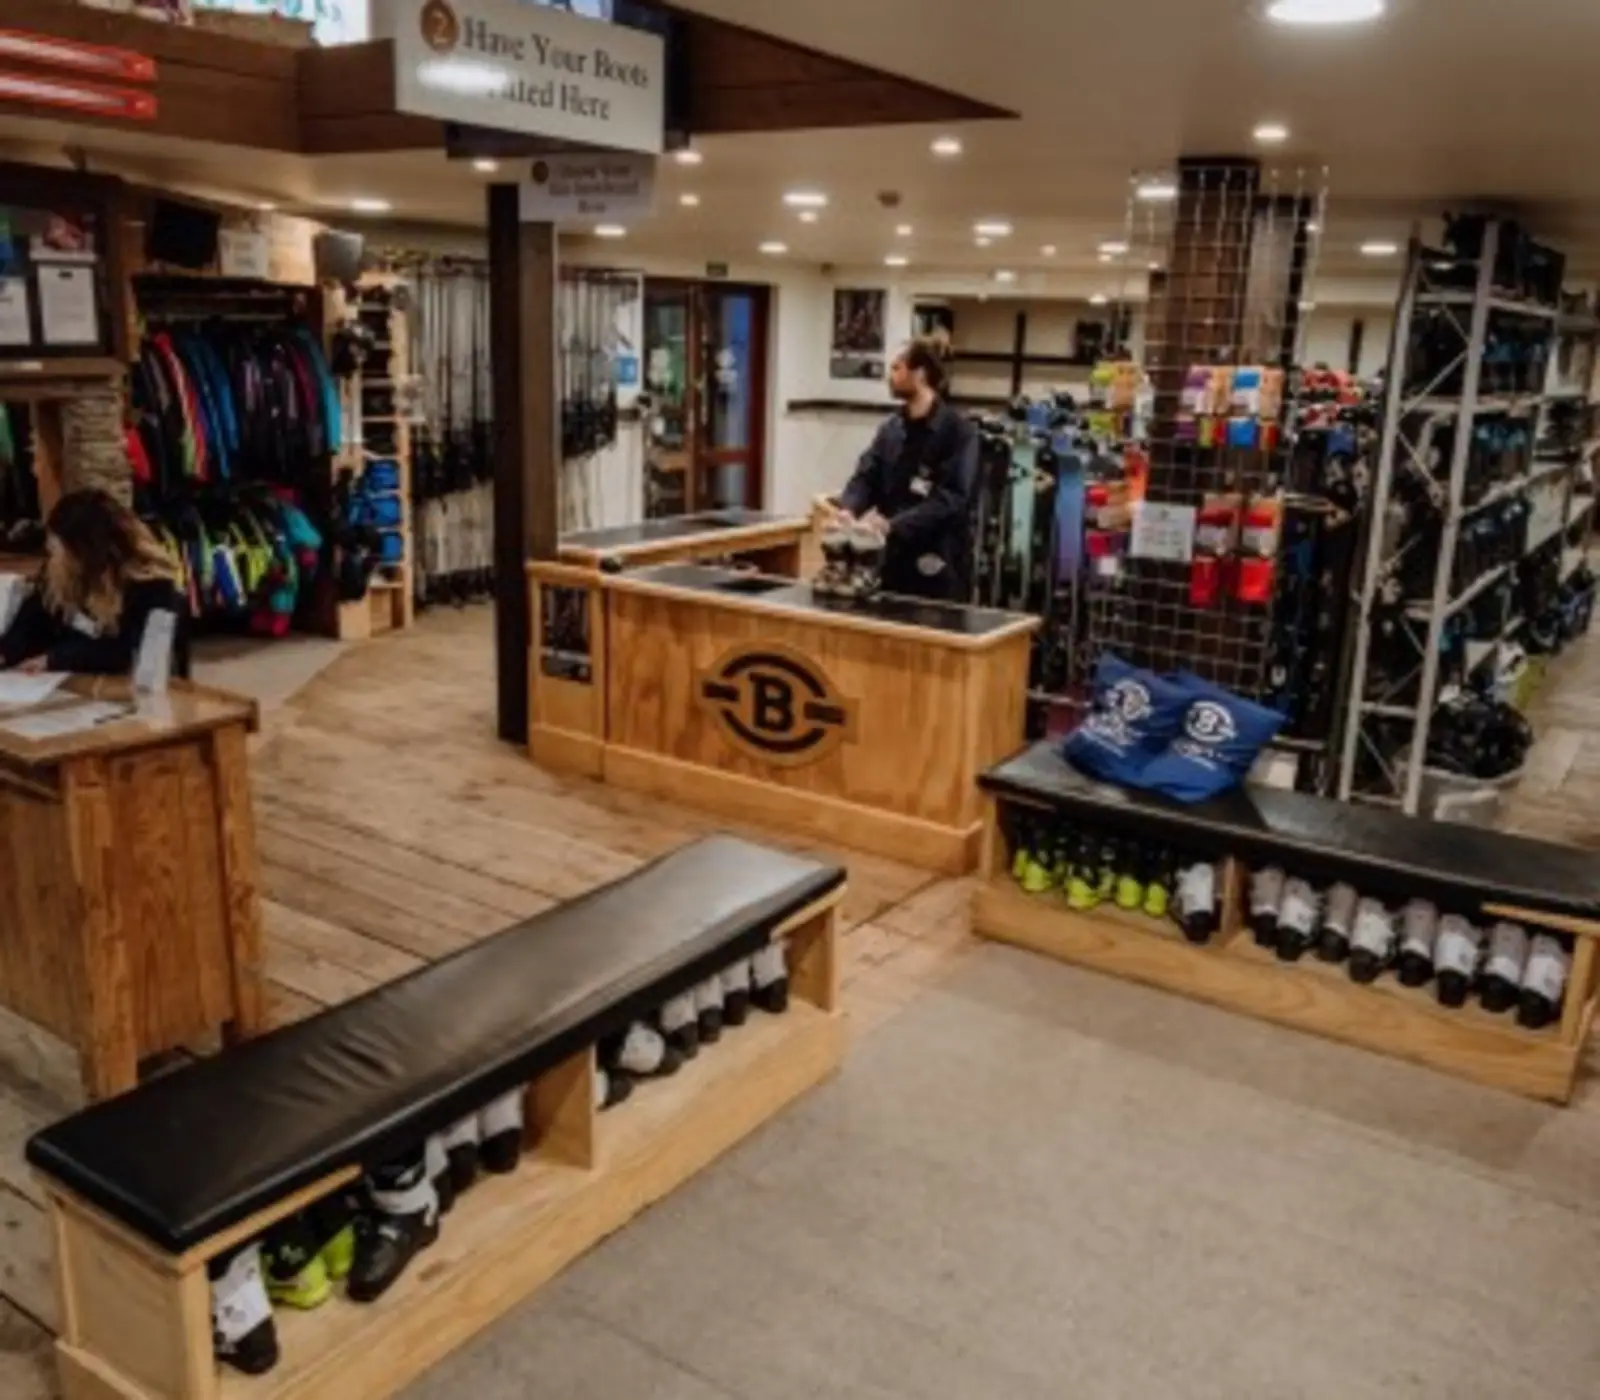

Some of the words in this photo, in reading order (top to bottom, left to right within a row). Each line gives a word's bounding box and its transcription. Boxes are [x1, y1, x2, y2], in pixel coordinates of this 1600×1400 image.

[463, 16, 526, 61] Have
[531, 33, 588, 74] Your
[594, 48, 648, 89] Boots
[560, 83, 610, 120] Here
[749, 672, 795, 732] B
